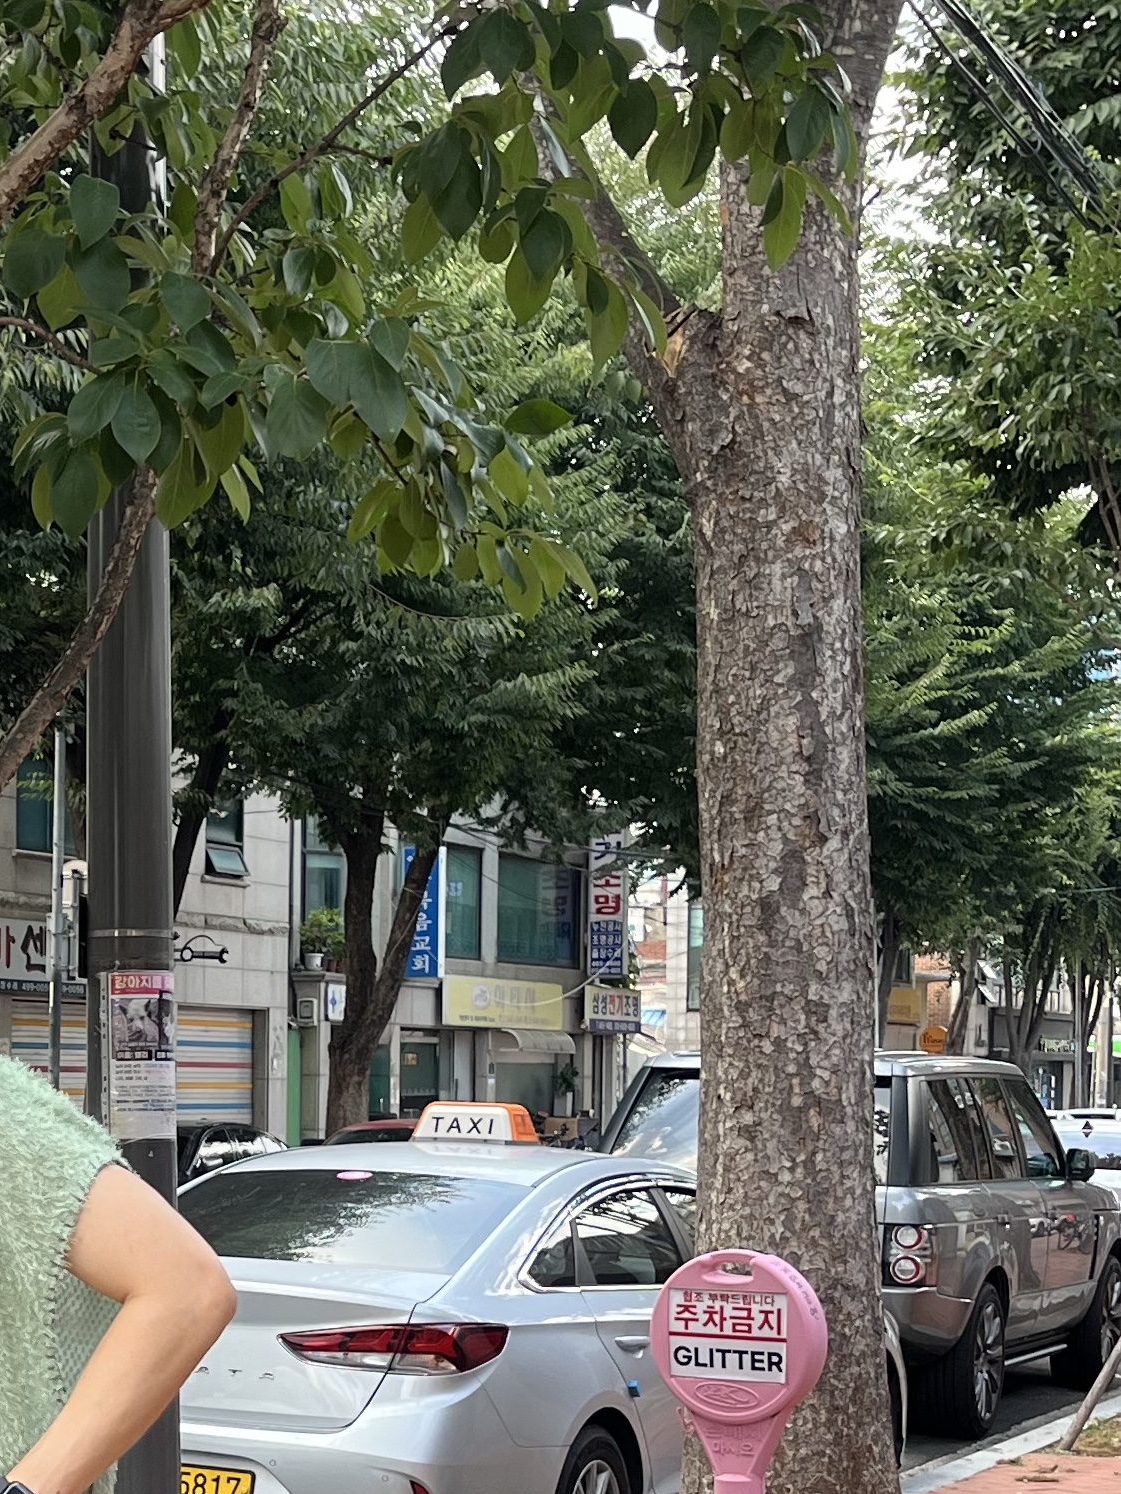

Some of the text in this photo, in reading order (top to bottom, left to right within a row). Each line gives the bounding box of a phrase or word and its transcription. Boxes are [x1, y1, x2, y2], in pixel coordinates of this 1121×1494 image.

[592, 992, 640, 1018] 삼성전기조명
[431, 1115, 495, 1135] TAXI
[707, 1291, 776, 1308] 부탁드립니다
[673, 1303, 783, 1337] 주차금지
[672, 1344, 784, 1374] GLITTER
